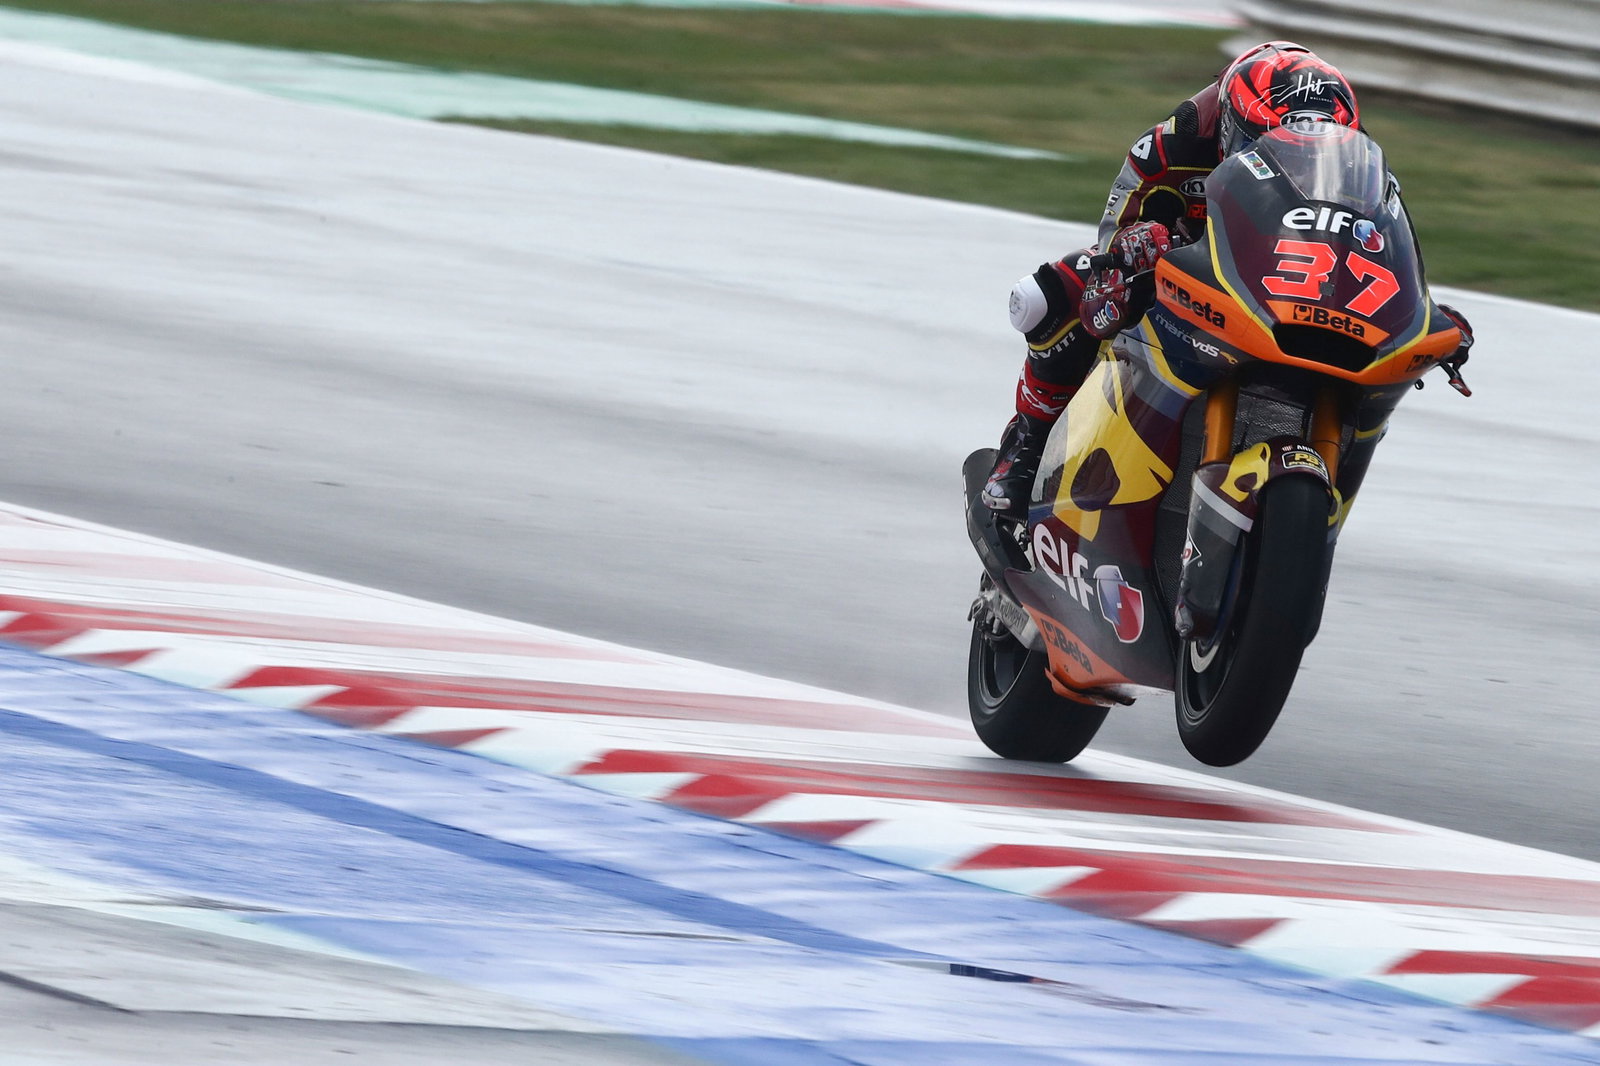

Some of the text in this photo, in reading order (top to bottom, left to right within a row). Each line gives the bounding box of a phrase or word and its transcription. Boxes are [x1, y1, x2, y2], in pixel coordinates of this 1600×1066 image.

[1277, 72, 1339, 103] Hit
[1282, 207, 1353, 233] elf
[1261, 239, 1400, 317] 37
[1093, 308, 1110, 330] elf
[1178, 287, 1226, 329] Beta
[1312, 309, 1365, 338] Beta
[1033, 522, 1094, 612] elf
[1054, 625, 1094, 675] Beta
